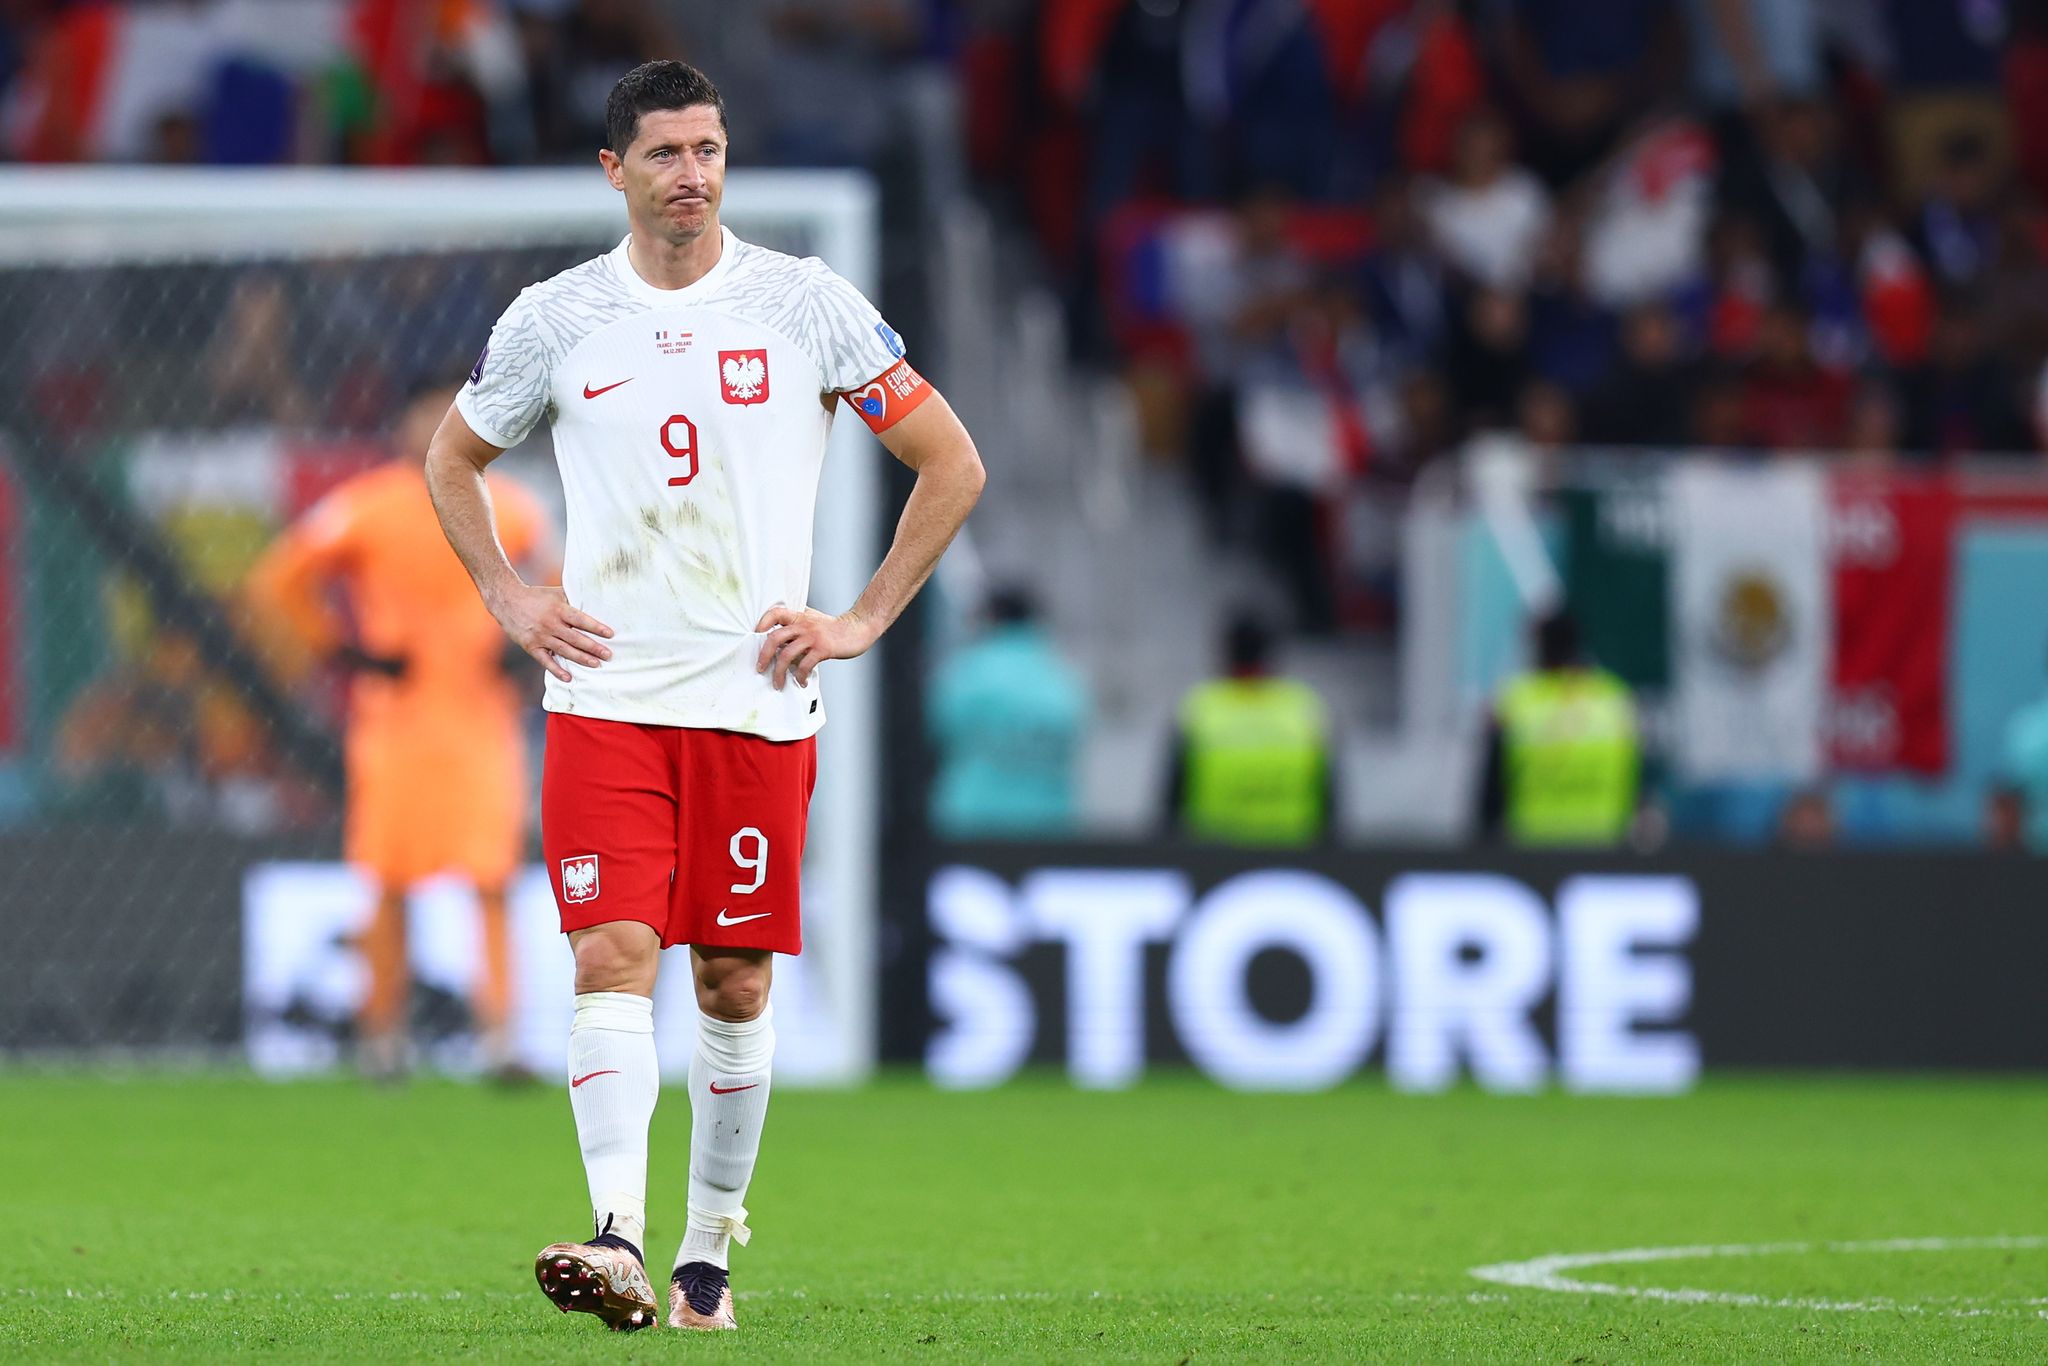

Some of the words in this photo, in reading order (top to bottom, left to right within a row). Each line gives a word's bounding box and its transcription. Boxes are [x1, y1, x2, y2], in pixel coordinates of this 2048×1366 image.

[663, 347, 686, 355] 04.12.2022
[894, 380, 915, 401] FOR
[660, 414, 699, 487] 9
[729, 826, 769, 895] 9
[926, 864, 1701, 1094] STORE
